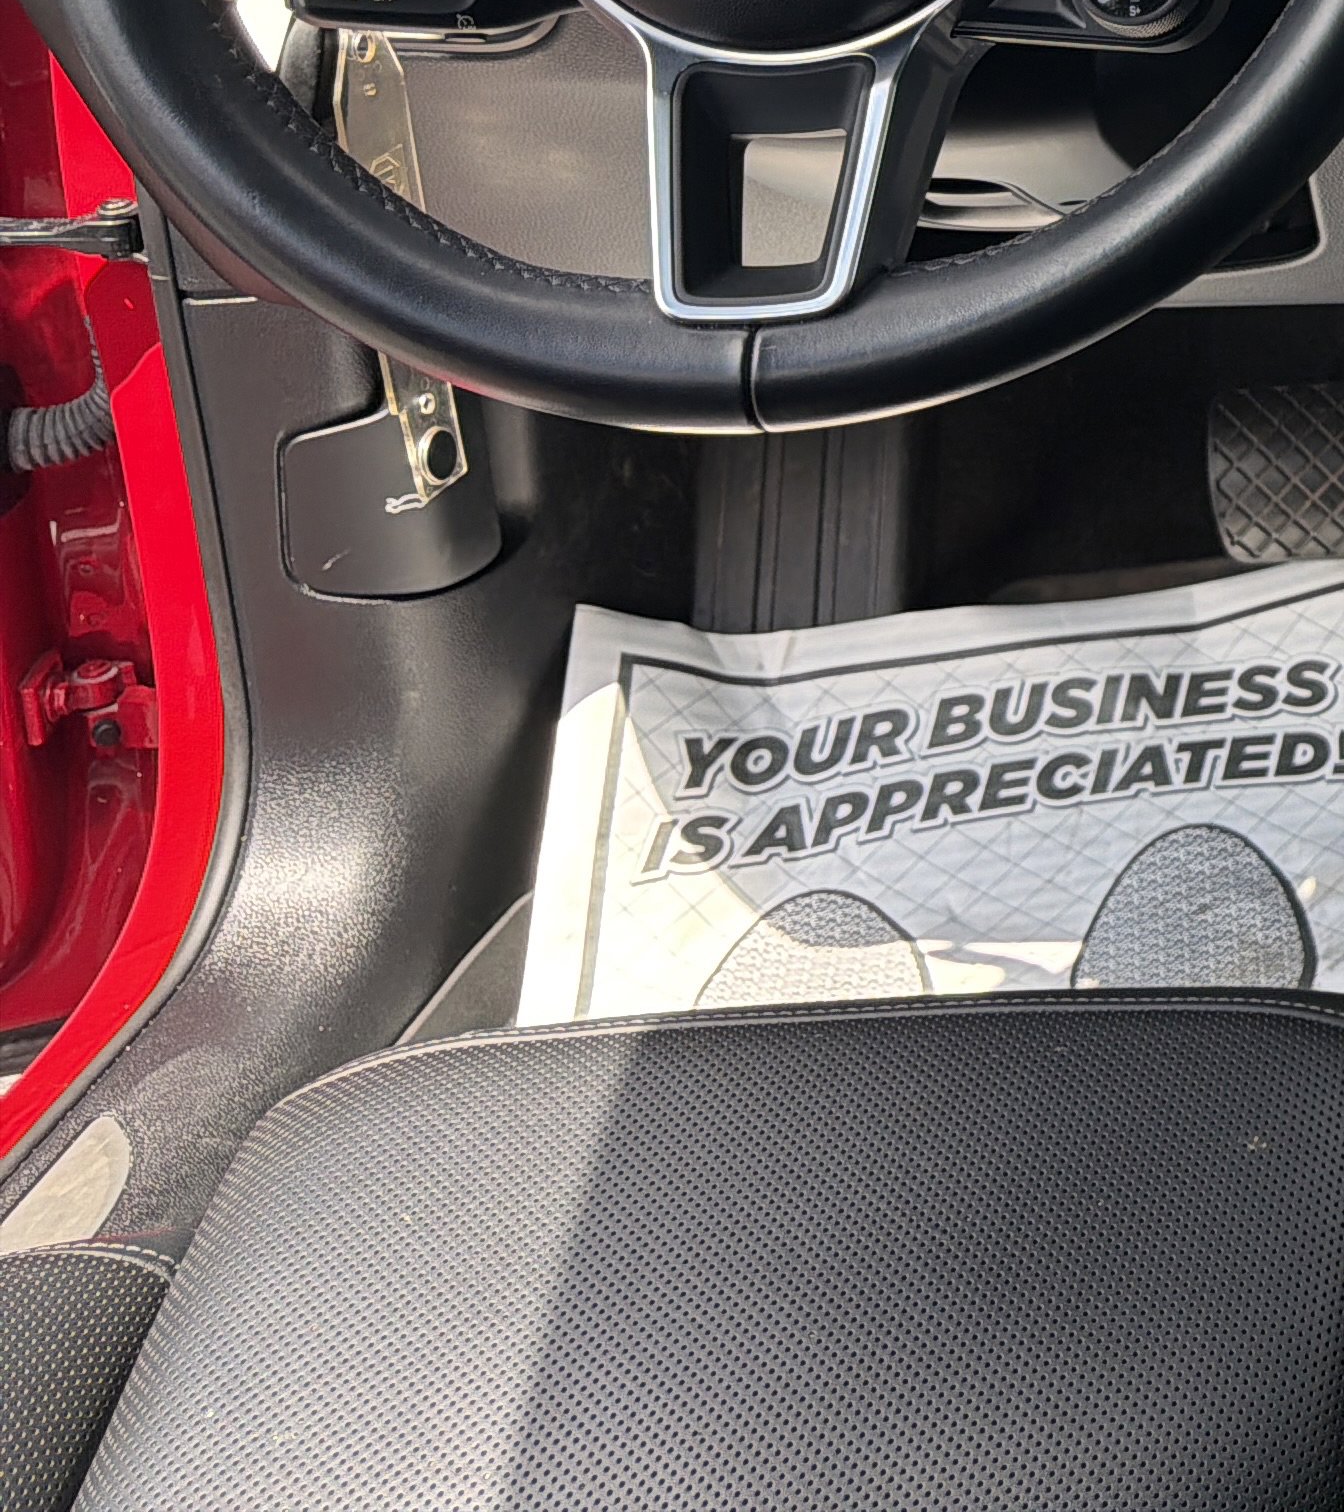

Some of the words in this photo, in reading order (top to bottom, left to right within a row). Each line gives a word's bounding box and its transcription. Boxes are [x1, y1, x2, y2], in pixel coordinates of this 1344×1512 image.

[676, 708, 910, 791] YOUR
[926, 658, 1337, 744] BUSINESS
[648, 814, 730, 875] IS
